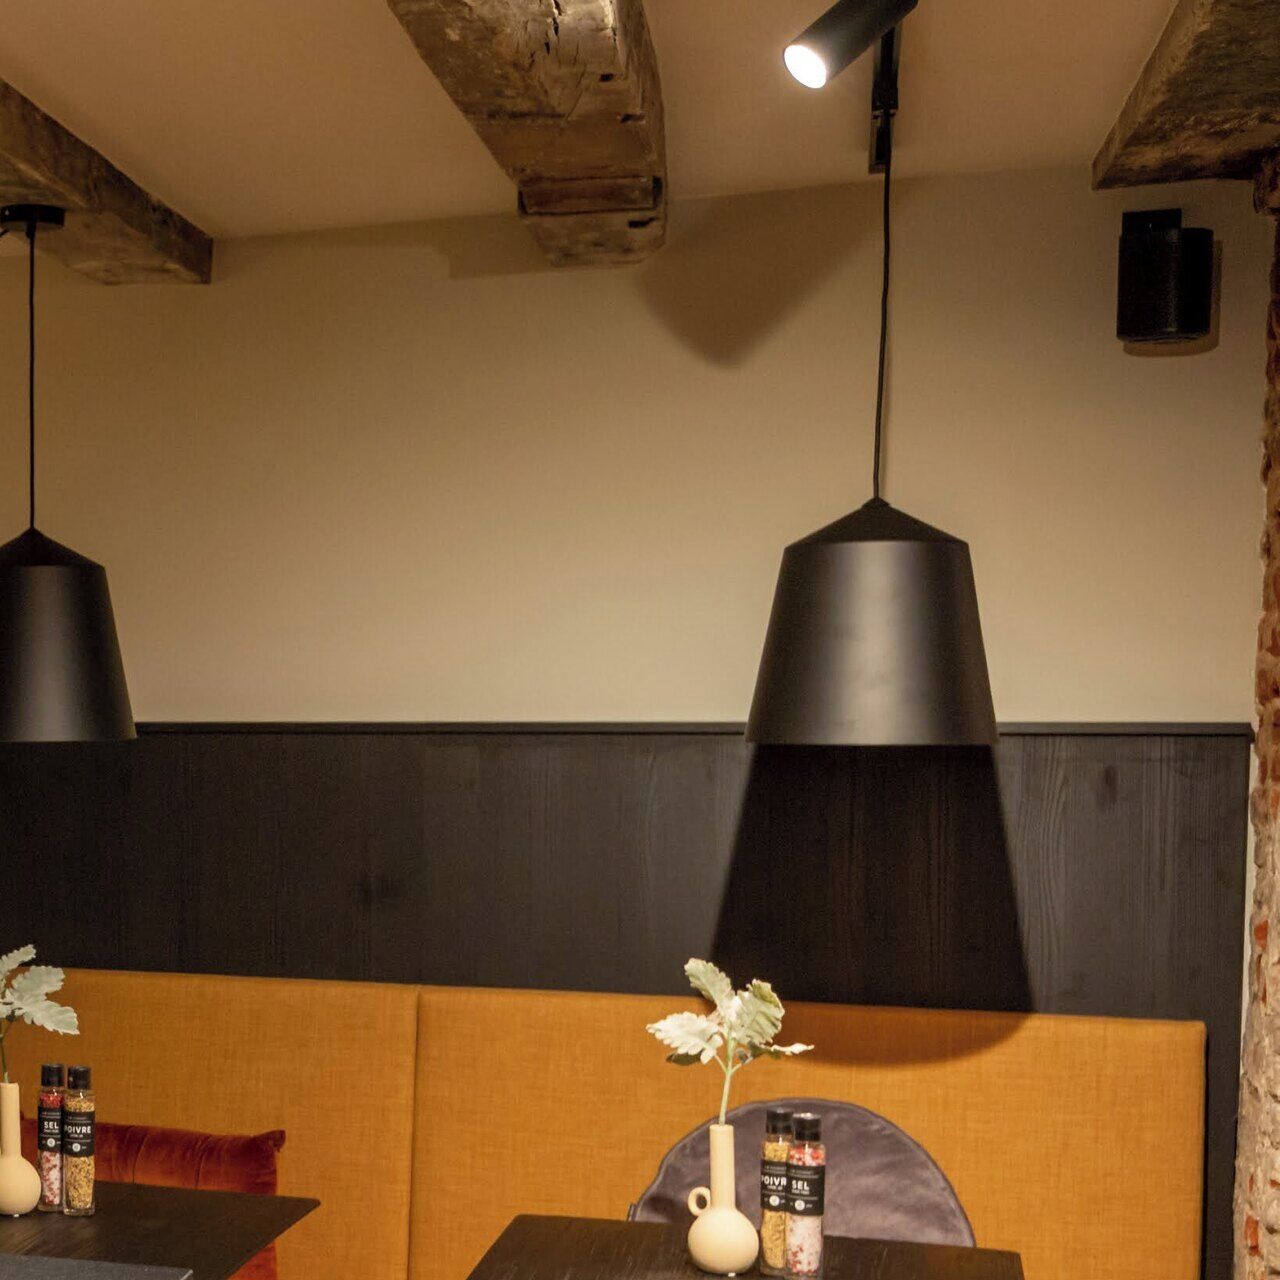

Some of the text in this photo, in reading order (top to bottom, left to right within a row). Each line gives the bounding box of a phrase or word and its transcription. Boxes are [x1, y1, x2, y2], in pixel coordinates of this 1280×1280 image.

[44, 1121, 59, 1129] SEL
[760, 1175, 787, 1187] POIVR
[792, 1180, 810, 1190] SEL
